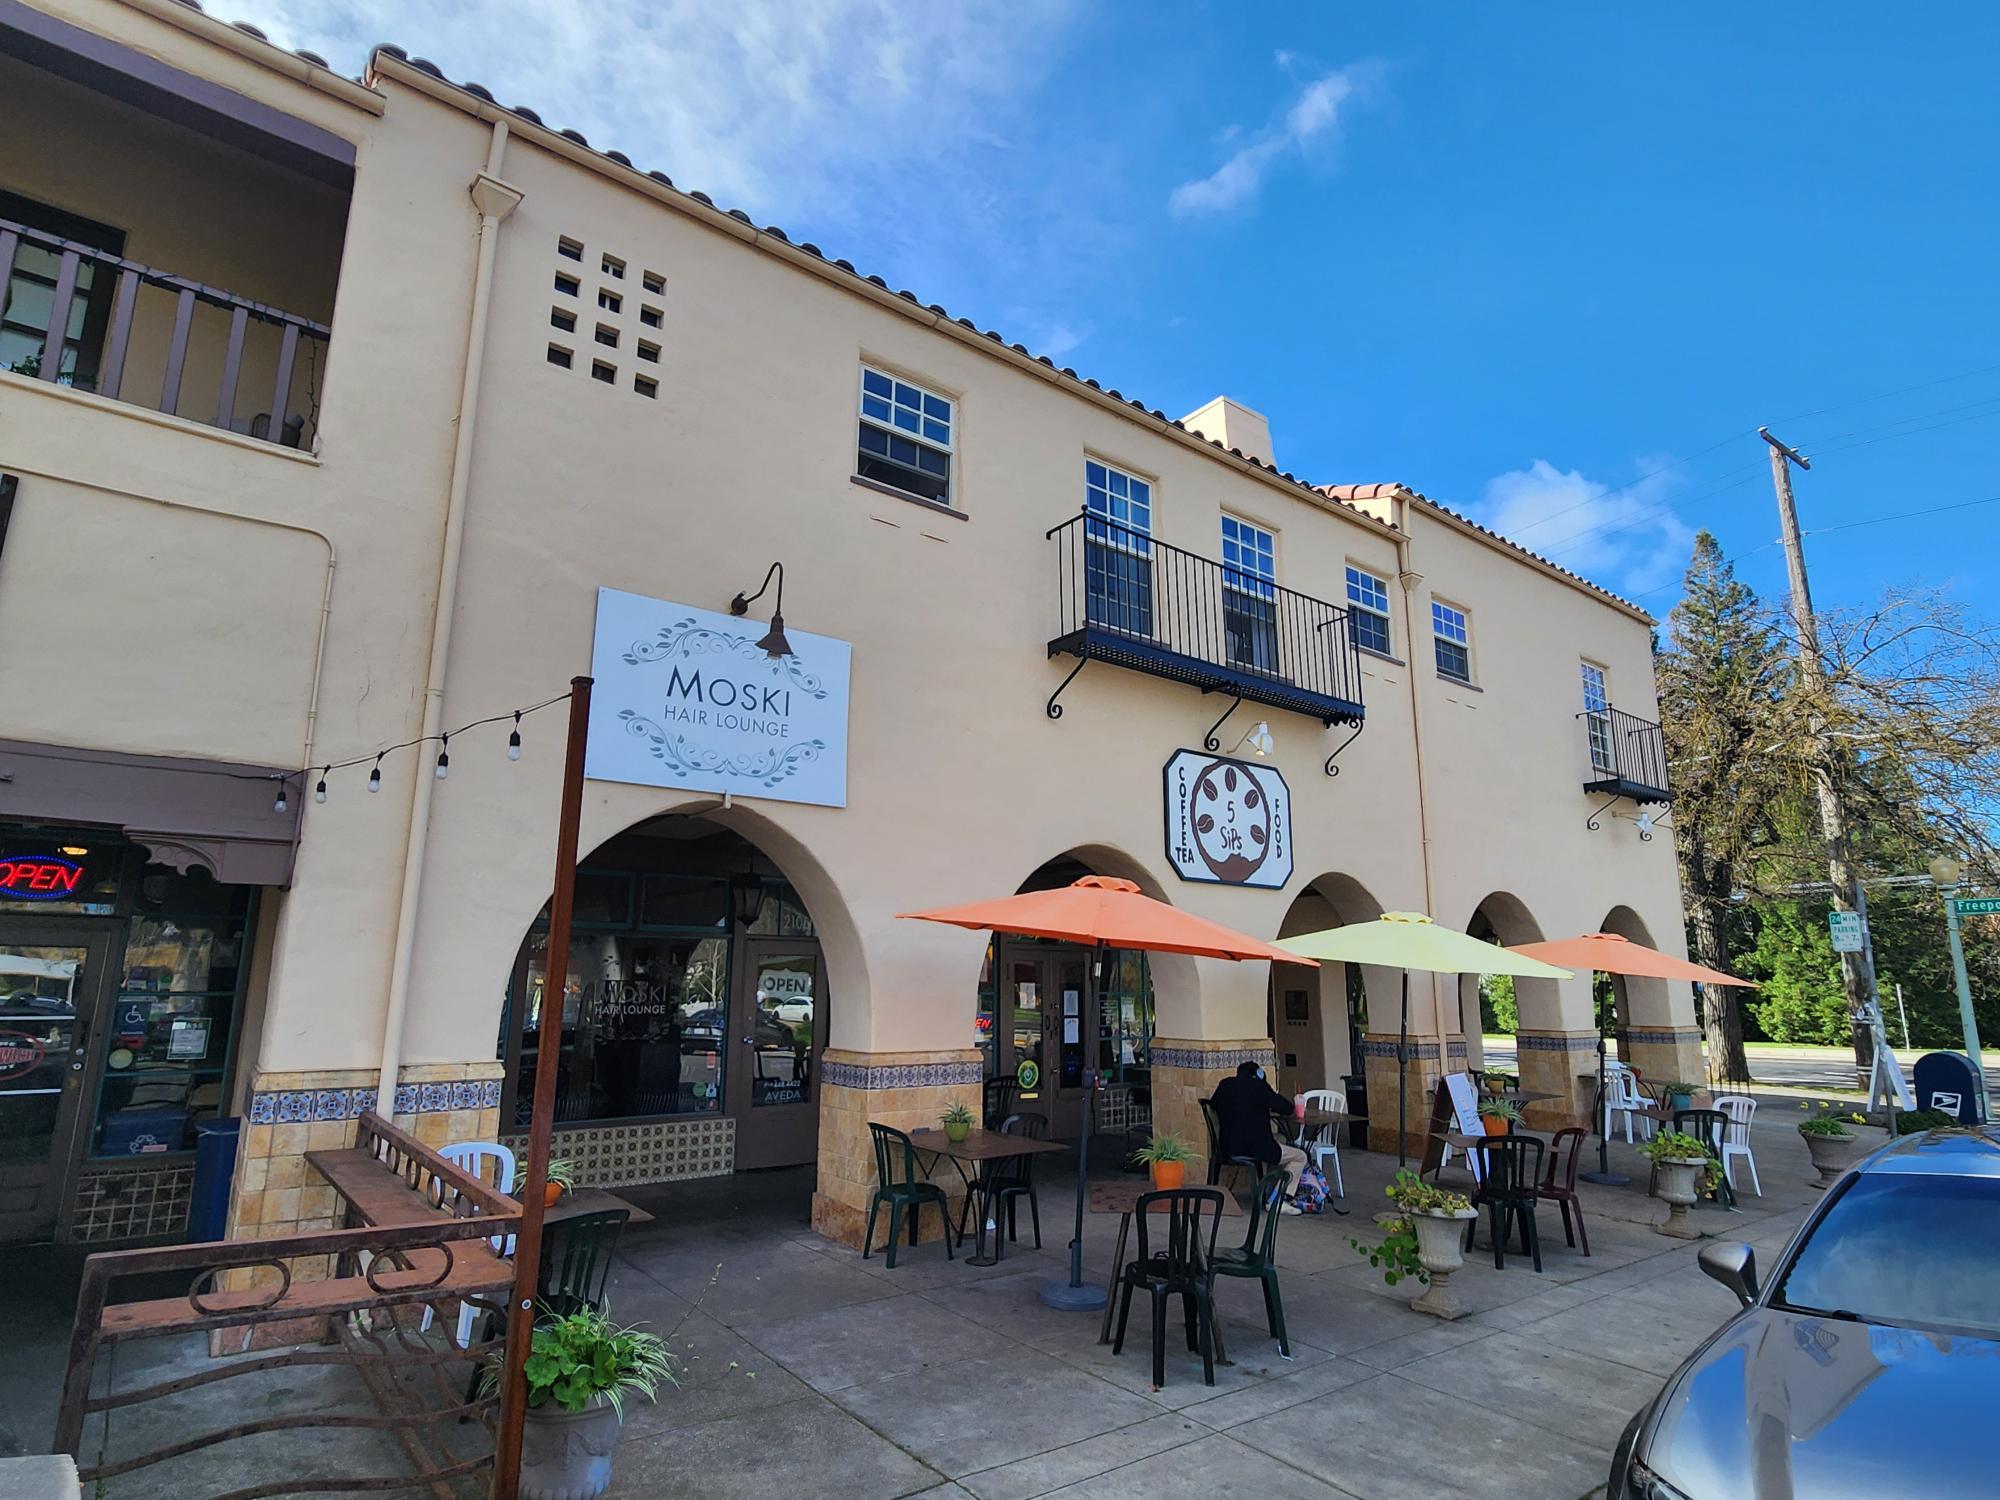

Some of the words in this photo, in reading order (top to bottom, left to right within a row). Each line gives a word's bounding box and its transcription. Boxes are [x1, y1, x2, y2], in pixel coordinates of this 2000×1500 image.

[666, 664, 790, 717] MOSKI
[664, 704, 708, 726] HAIR
[716, 713, 789, 738] LOUNGE
[1178, 766, 1188, 847] COFFEE
[1227, 801, 1235, 823] 5
[1274, 798, 1282, 859] FOOD
[1175, 846, 1195, 864] TEA
[0, 862, 83, 890] OPEN
[764, 976, 807, 993] OPEN
[594, 1004, 619, 1016] HAIR
[623, 1004, 666, 1015] LOUNGE
[975, 1018, 991, 1028] EN
[765, 1090, 800, 1102] AVEDA
